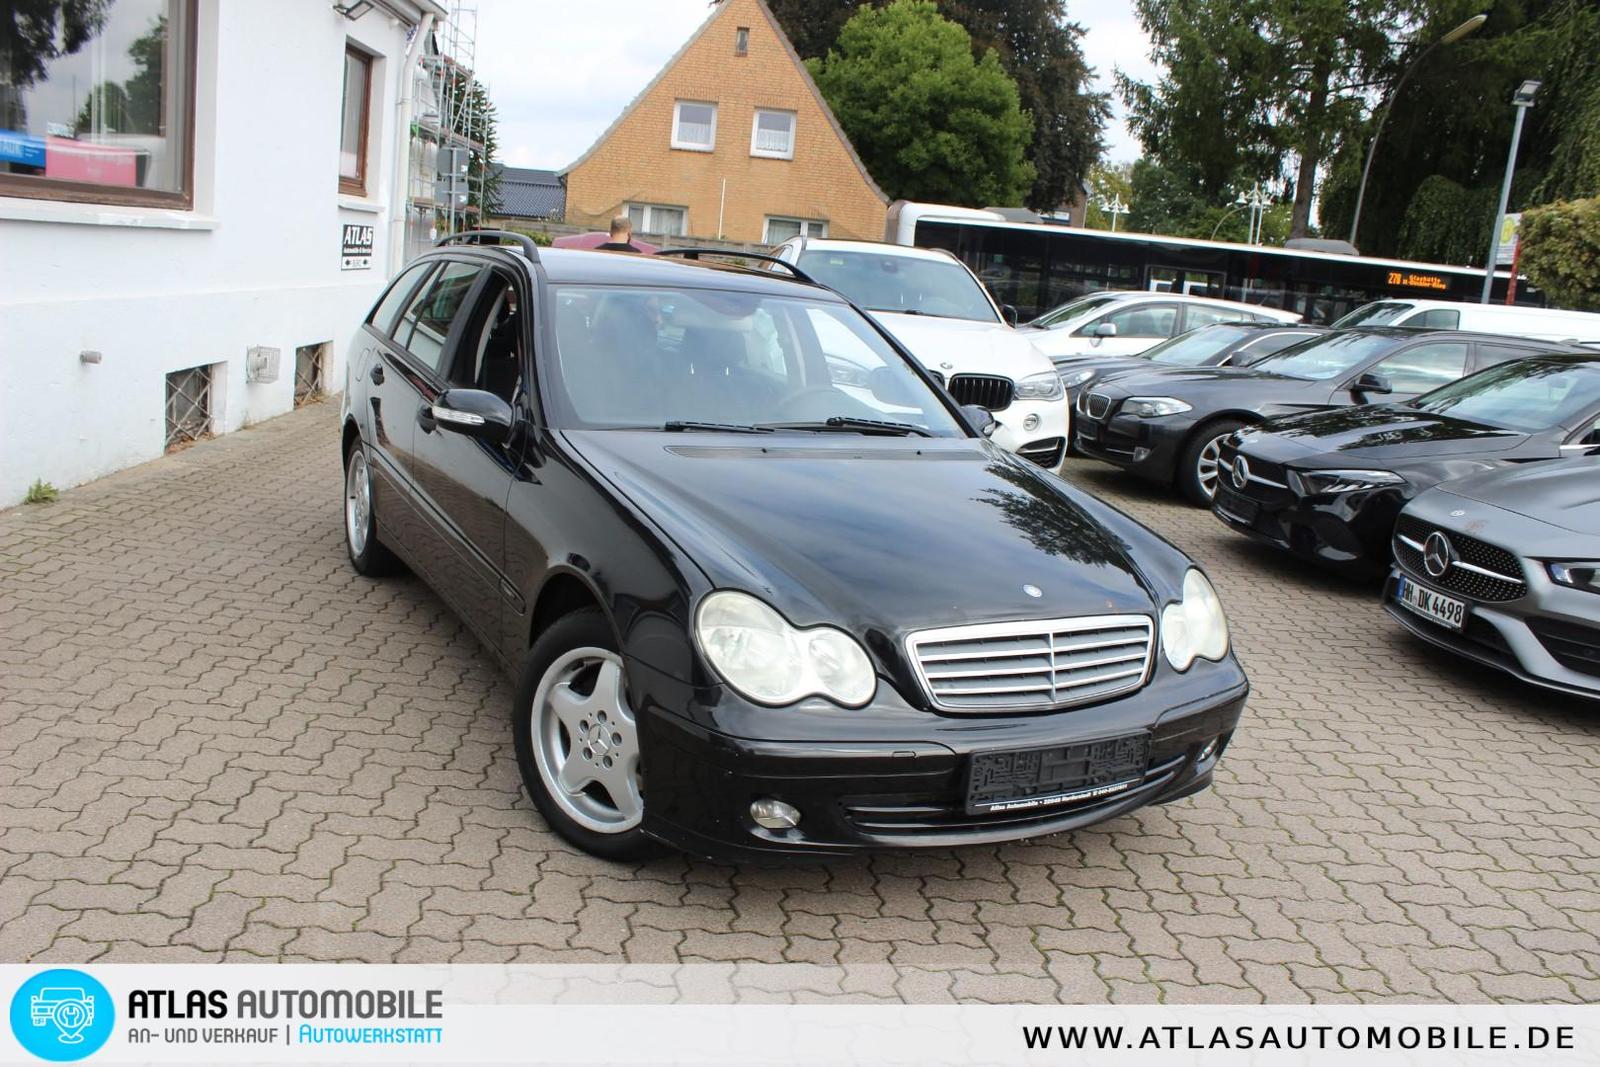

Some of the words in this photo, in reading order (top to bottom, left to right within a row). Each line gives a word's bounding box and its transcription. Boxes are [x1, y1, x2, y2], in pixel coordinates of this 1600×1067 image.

[344, 226, 373, 245] ATLAS
[1418, 588, 1432, 612] DK
[1432, 596, 1462, 623] 4498
